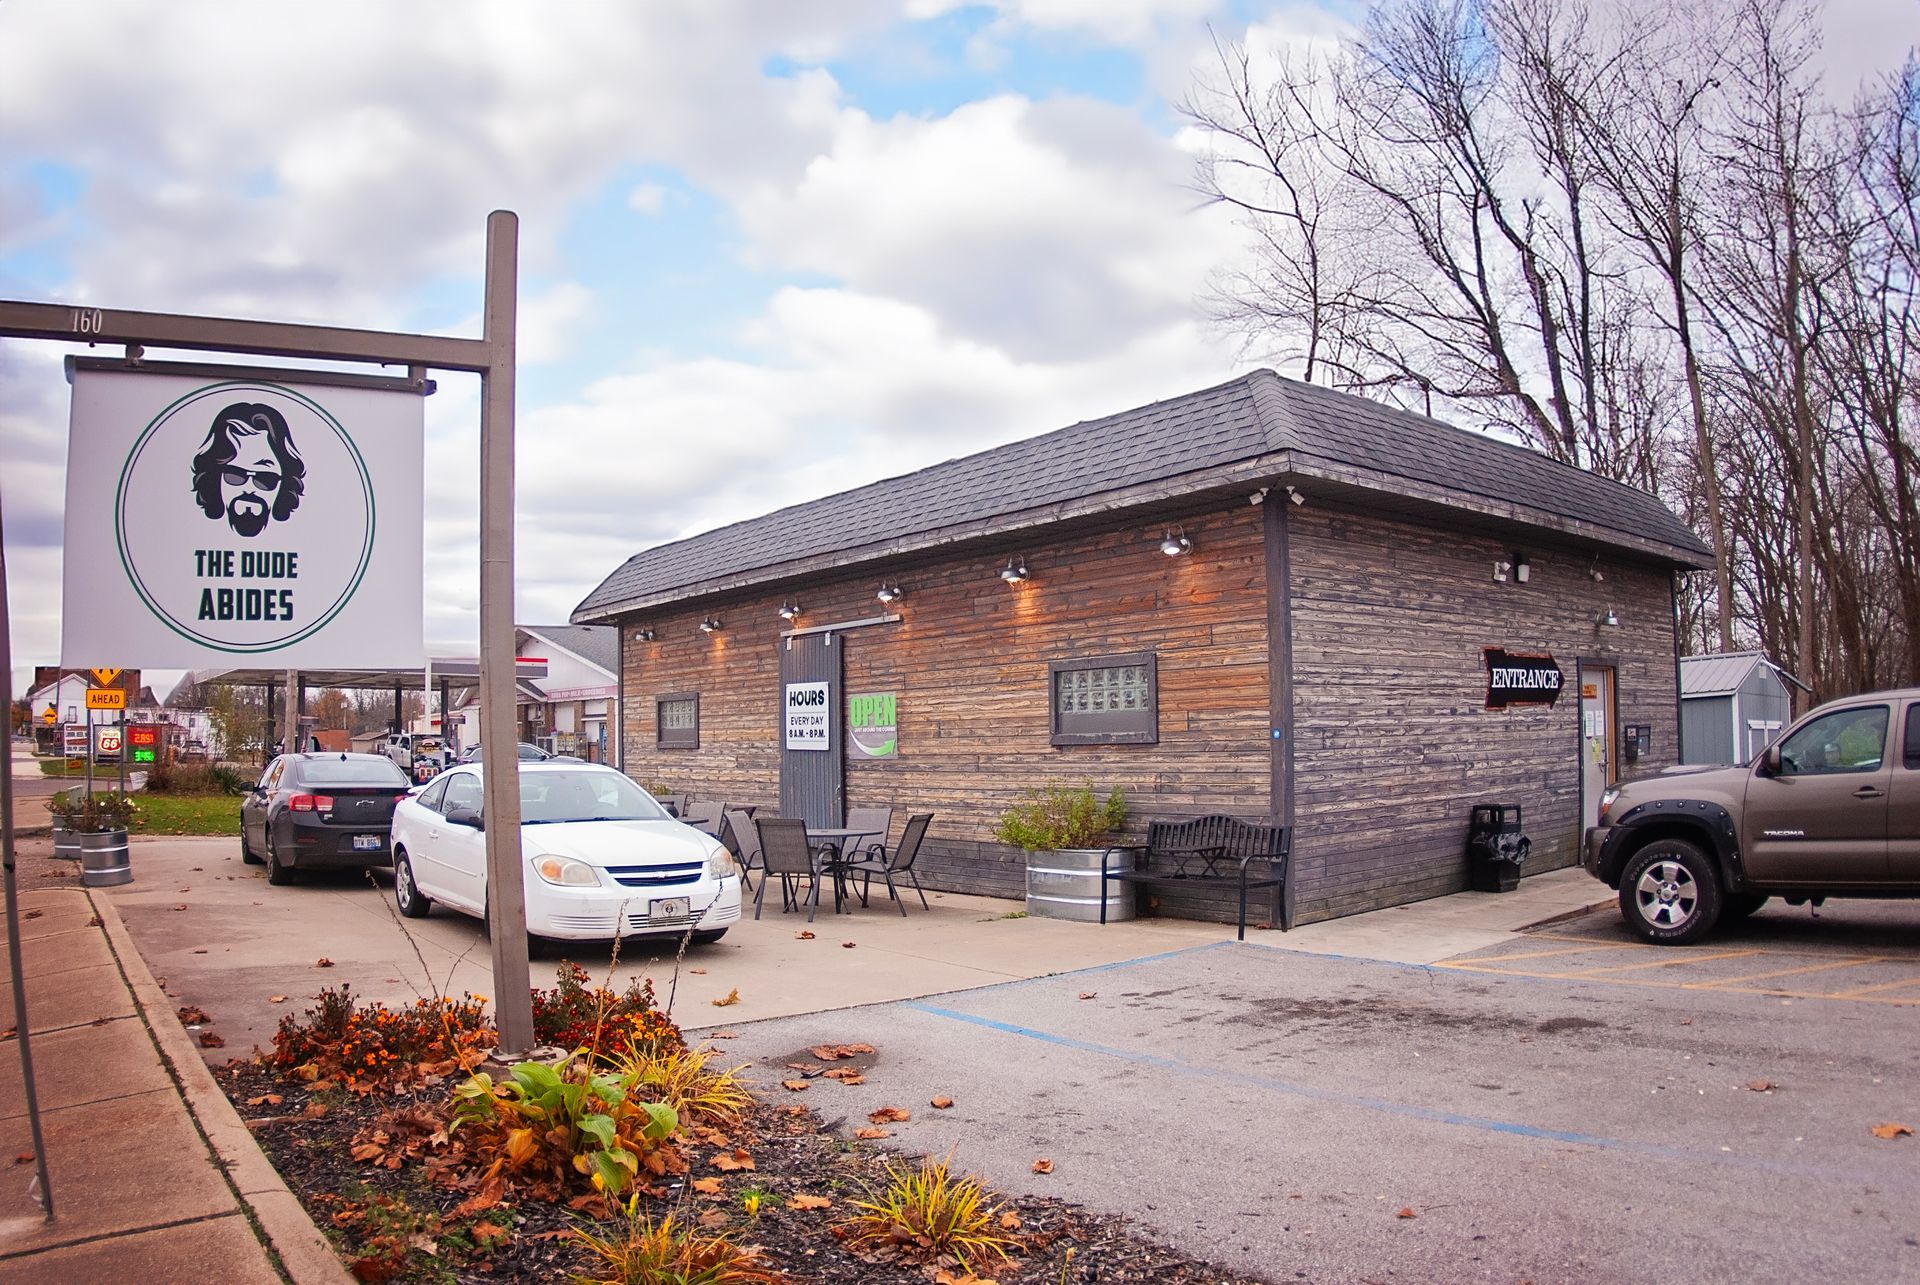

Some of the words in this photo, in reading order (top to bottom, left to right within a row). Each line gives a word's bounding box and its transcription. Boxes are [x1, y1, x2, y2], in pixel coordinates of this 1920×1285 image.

[72, 308, 102, 334] 160
[194, 549, 235, 578] THE
[240, 550, 298, 579] DUDE
[198, 588, 294, 621] ABIDES
[1491, 667, 1559, 689] ENTRANCE
[91, 695, 120, 704] AHEAD
[789, 690, 825, 707] HOURS
[790, 716, 809, 725] EVERY
[811, 716, 824, 725] DAY
[850, 695, 896, 728] OPEN
[103, 738, 117, 749] 66
